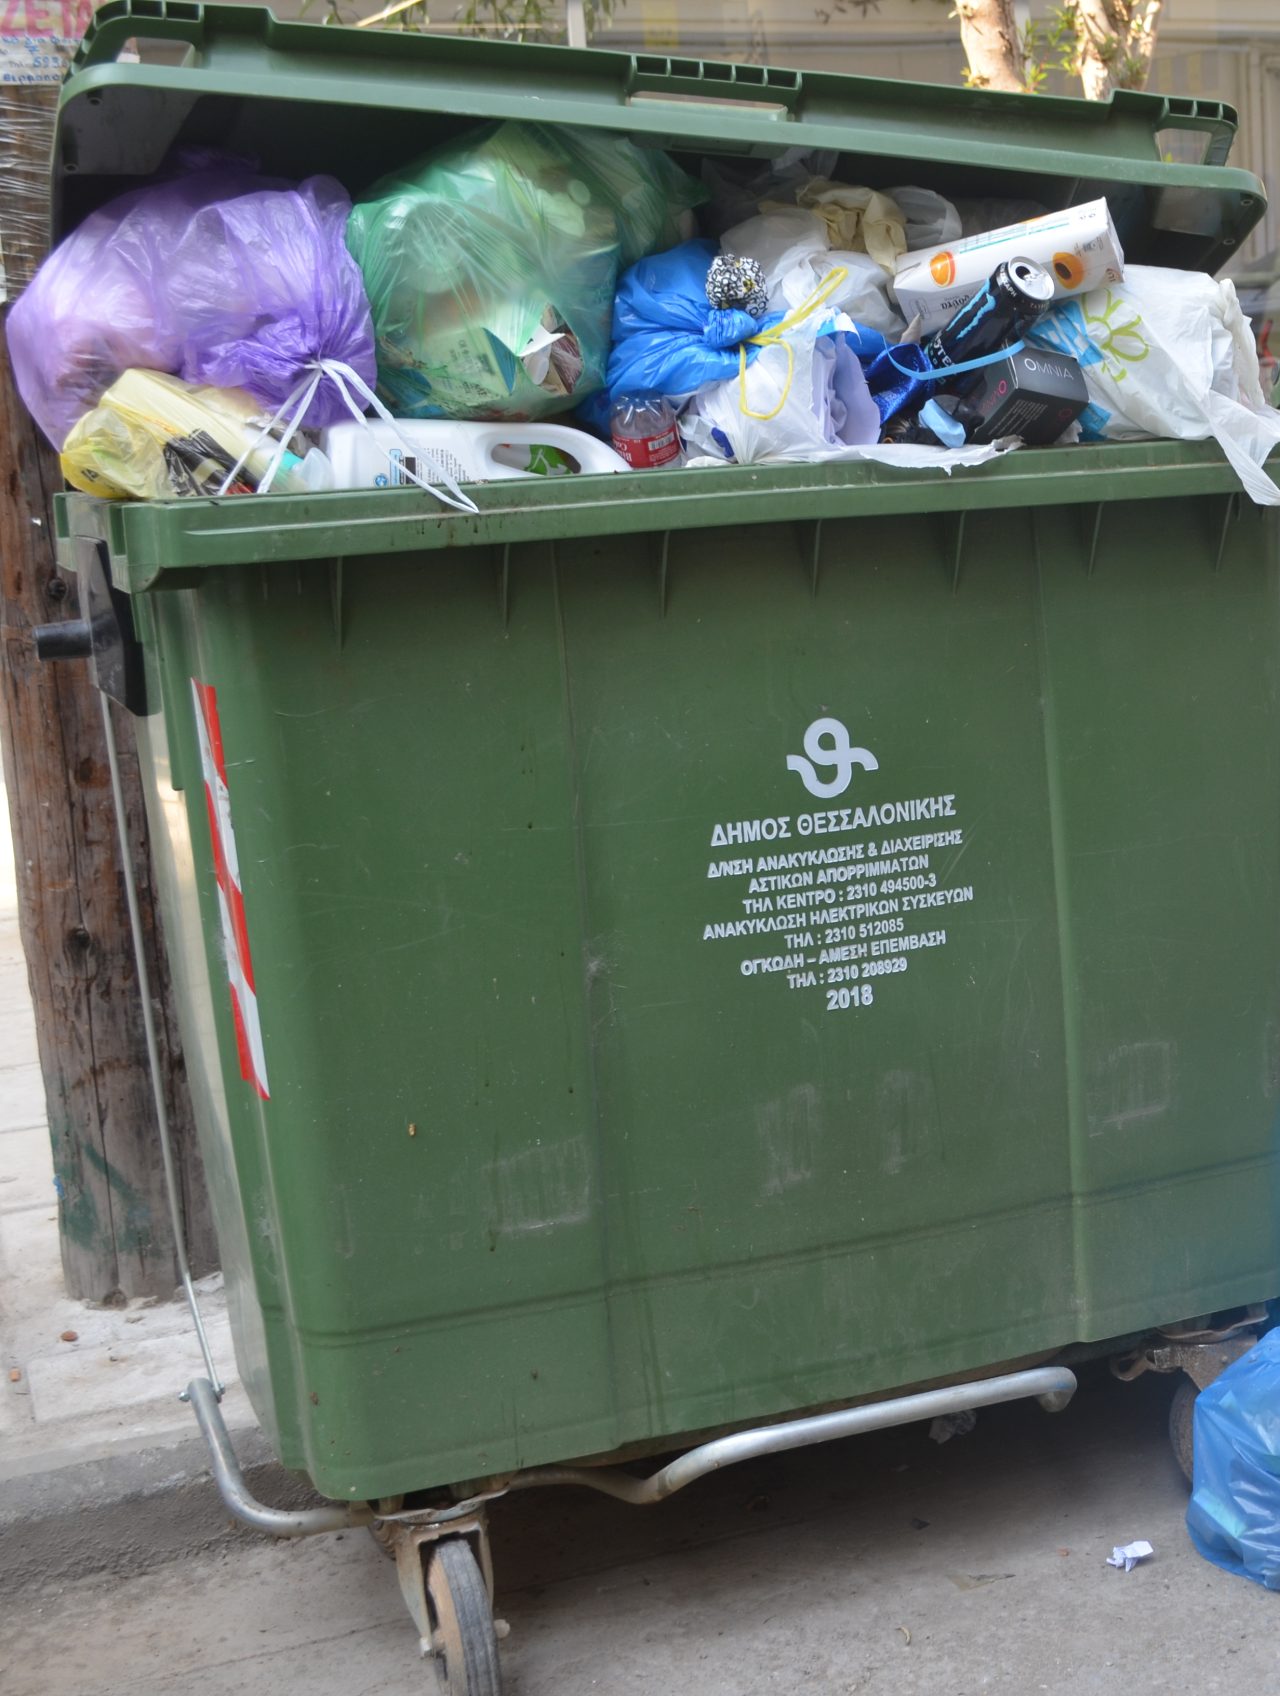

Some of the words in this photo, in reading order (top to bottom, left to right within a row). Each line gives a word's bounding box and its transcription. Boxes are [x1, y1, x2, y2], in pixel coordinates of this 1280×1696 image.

[1024, 358, 1075, 381] OMNIA
[710, 816, 791, 847] ΔΗΜΟΣ
[797, 794, 956, 836] ΘΕΣΣΑΛΟΝΙΚΗΣ
[756, 843, 865, 872] ΑΝΑΚΥΚΛΩΣΗΣ
[867, 842, 878, 857] &
[880, 829, 963, 855] ΔΙΑΧΕΙΡΙΣΗΣ
[742, 897, 773, 914] ΤΗΛ
[776, 888, 836, 911] ΚΕΝΤΡΟ
[846, 883, 877, 901] 2310
[880, 873, 937, 895] 494500-3
[748, 869, 813, 894] ΑΣΤΙΚΩΝ
[816, 854, 929, 883] ΑΠΟΡΡΙΜΜΑΤΩΝ
[703, 913, 806, 940] ΑΝΑΚΥΚΛΩΣΗ
[809, 898, 899, 925] ΗΛΕΚΤΡΙΚΩΝ
[902, 886, 974, 911] ΣΥΣΚΕΥΩΝ
[784, 932, 814, 949] ΤΗΛ
[825, 927, 856, 945] 2310
[858, 917, 904, 939] 512085
[740, 951, 805, 976] ΟΓΚΩΔΗ
[818, 943, 868, 966] ΑΜΕΣΗ
[870, 930, 946, 956] ΕΠΕΜΒΑΣΗ
[787, 971, 816, 989] ΤΗΛ
[827, 966, 859, 985] 2310
[861, 957, 907, 979] 208929
[826, 984, 873, 1011] 2018
